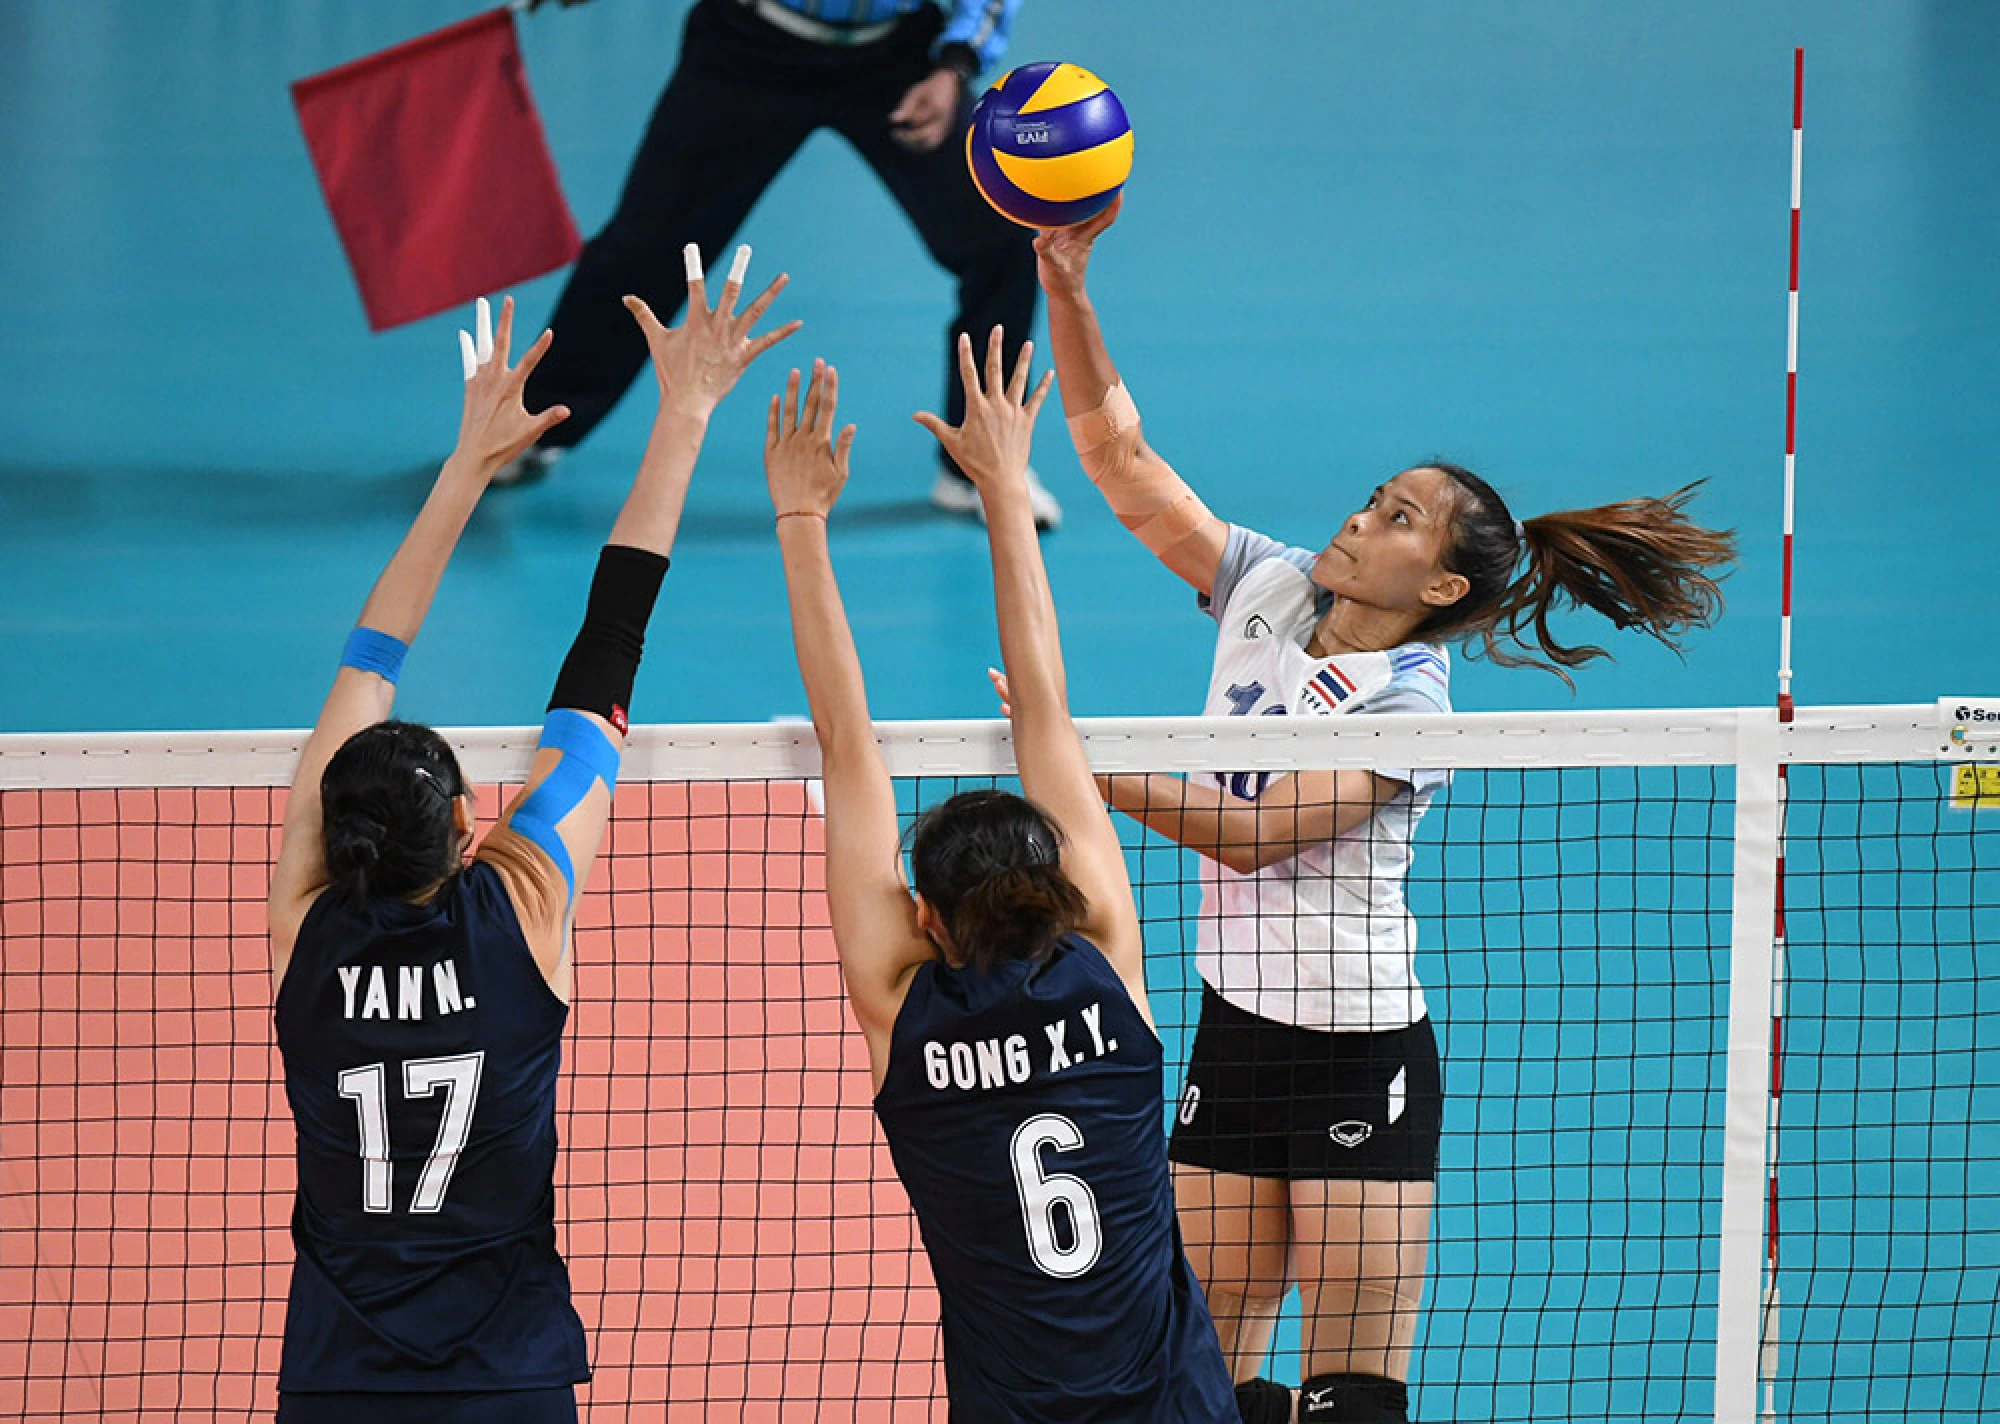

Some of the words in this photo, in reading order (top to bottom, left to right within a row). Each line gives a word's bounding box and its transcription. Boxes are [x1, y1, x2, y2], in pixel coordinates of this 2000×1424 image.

[1301, 687, 1331, 716] TH
[1973, 708, 2000, 721] Se
[337, 965, 423, 1021] YAN
[432, 958, 477, 1016] N.
[923, 1033, 1032, 1091] GONG
[337, 1049, 485, 1214] 17
[1009, 1112, 1103, 1279] 6
